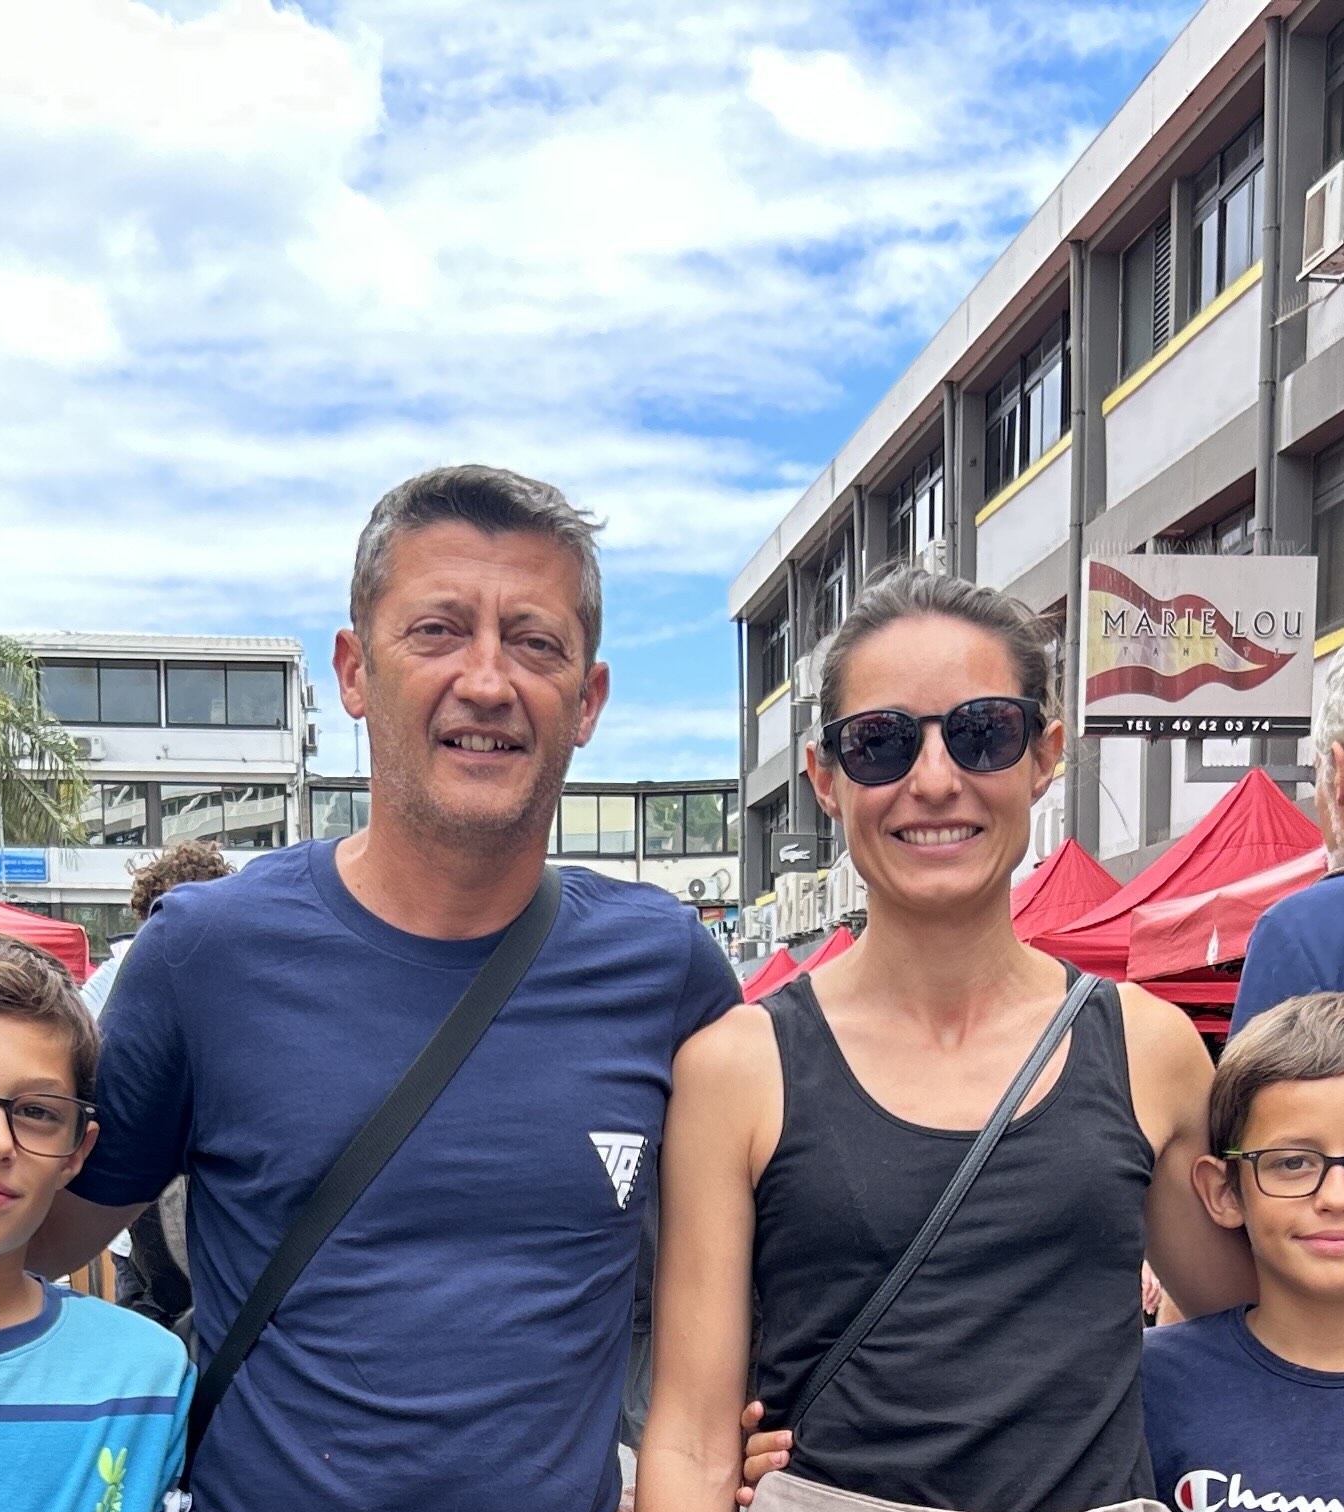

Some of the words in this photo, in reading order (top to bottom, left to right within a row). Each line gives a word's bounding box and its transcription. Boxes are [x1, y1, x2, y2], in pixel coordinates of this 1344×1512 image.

[1102, 608, 1217, 638] MARIE
[1233, 609, 1303, 638] LOU
[1122, 647, 1281, 659] TAHITI
[1126, 719, 1152, 731] TEL
[1171, 719, 1191, 732] 40
[1198, 719, 1217, 732] 42
[1224, 719, 1244, 732] 03
[1251, 719, 1270, 732] 74
